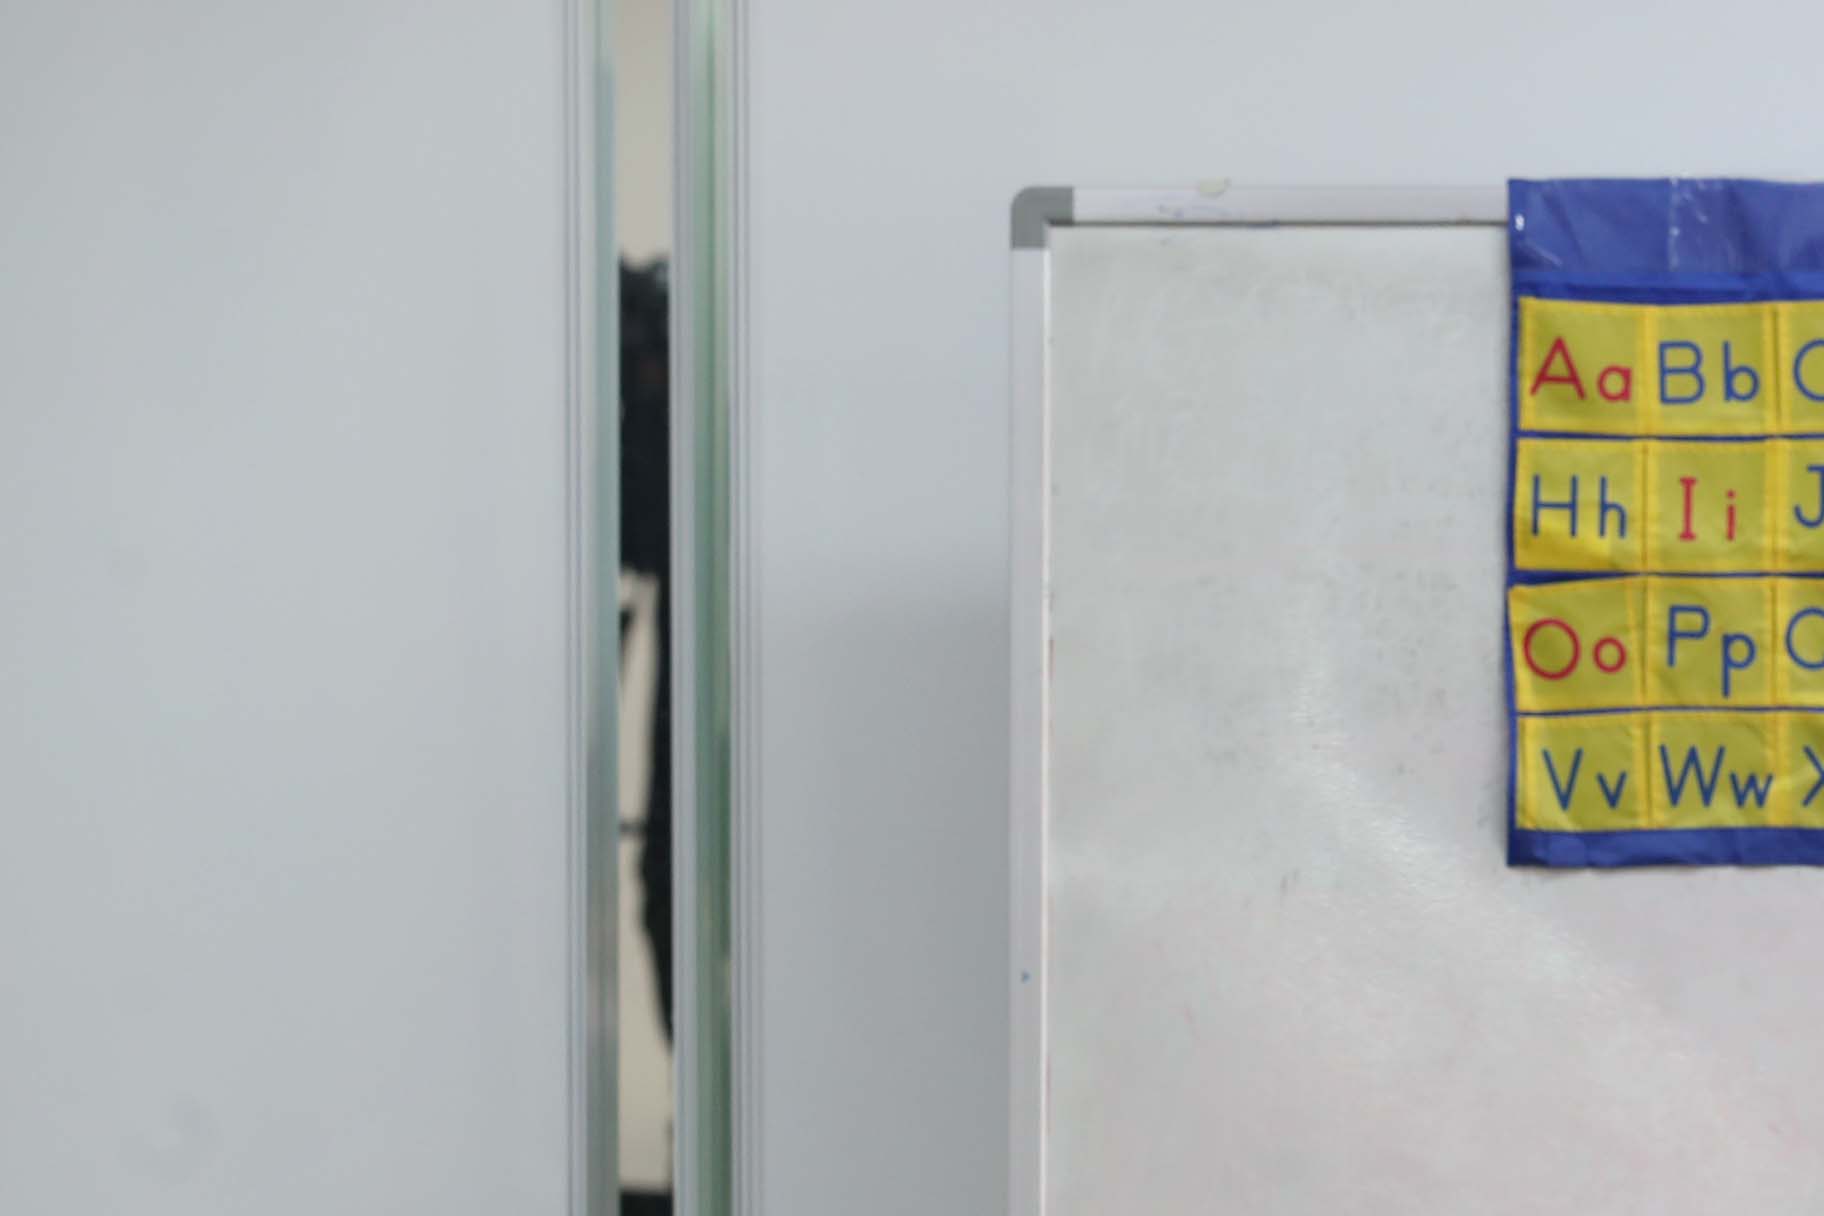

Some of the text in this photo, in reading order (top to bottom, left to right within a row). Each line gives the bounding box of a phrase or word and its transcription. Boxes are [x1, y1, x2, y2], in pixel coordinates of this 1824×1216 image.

[1529, 336, 1633, 403] Aa
[1658, 339, 1761, 405] Bb
[1532, 475, 1627, 538] Hh
[1678, 475, 1737, 543] Ii
[1521, 617, 1628, 681] Oo
[1667, 604, 1758, 697] Pp
[1542, 749, 1628, 811] Vv
[1659, 745, 1774, 809] Ww
